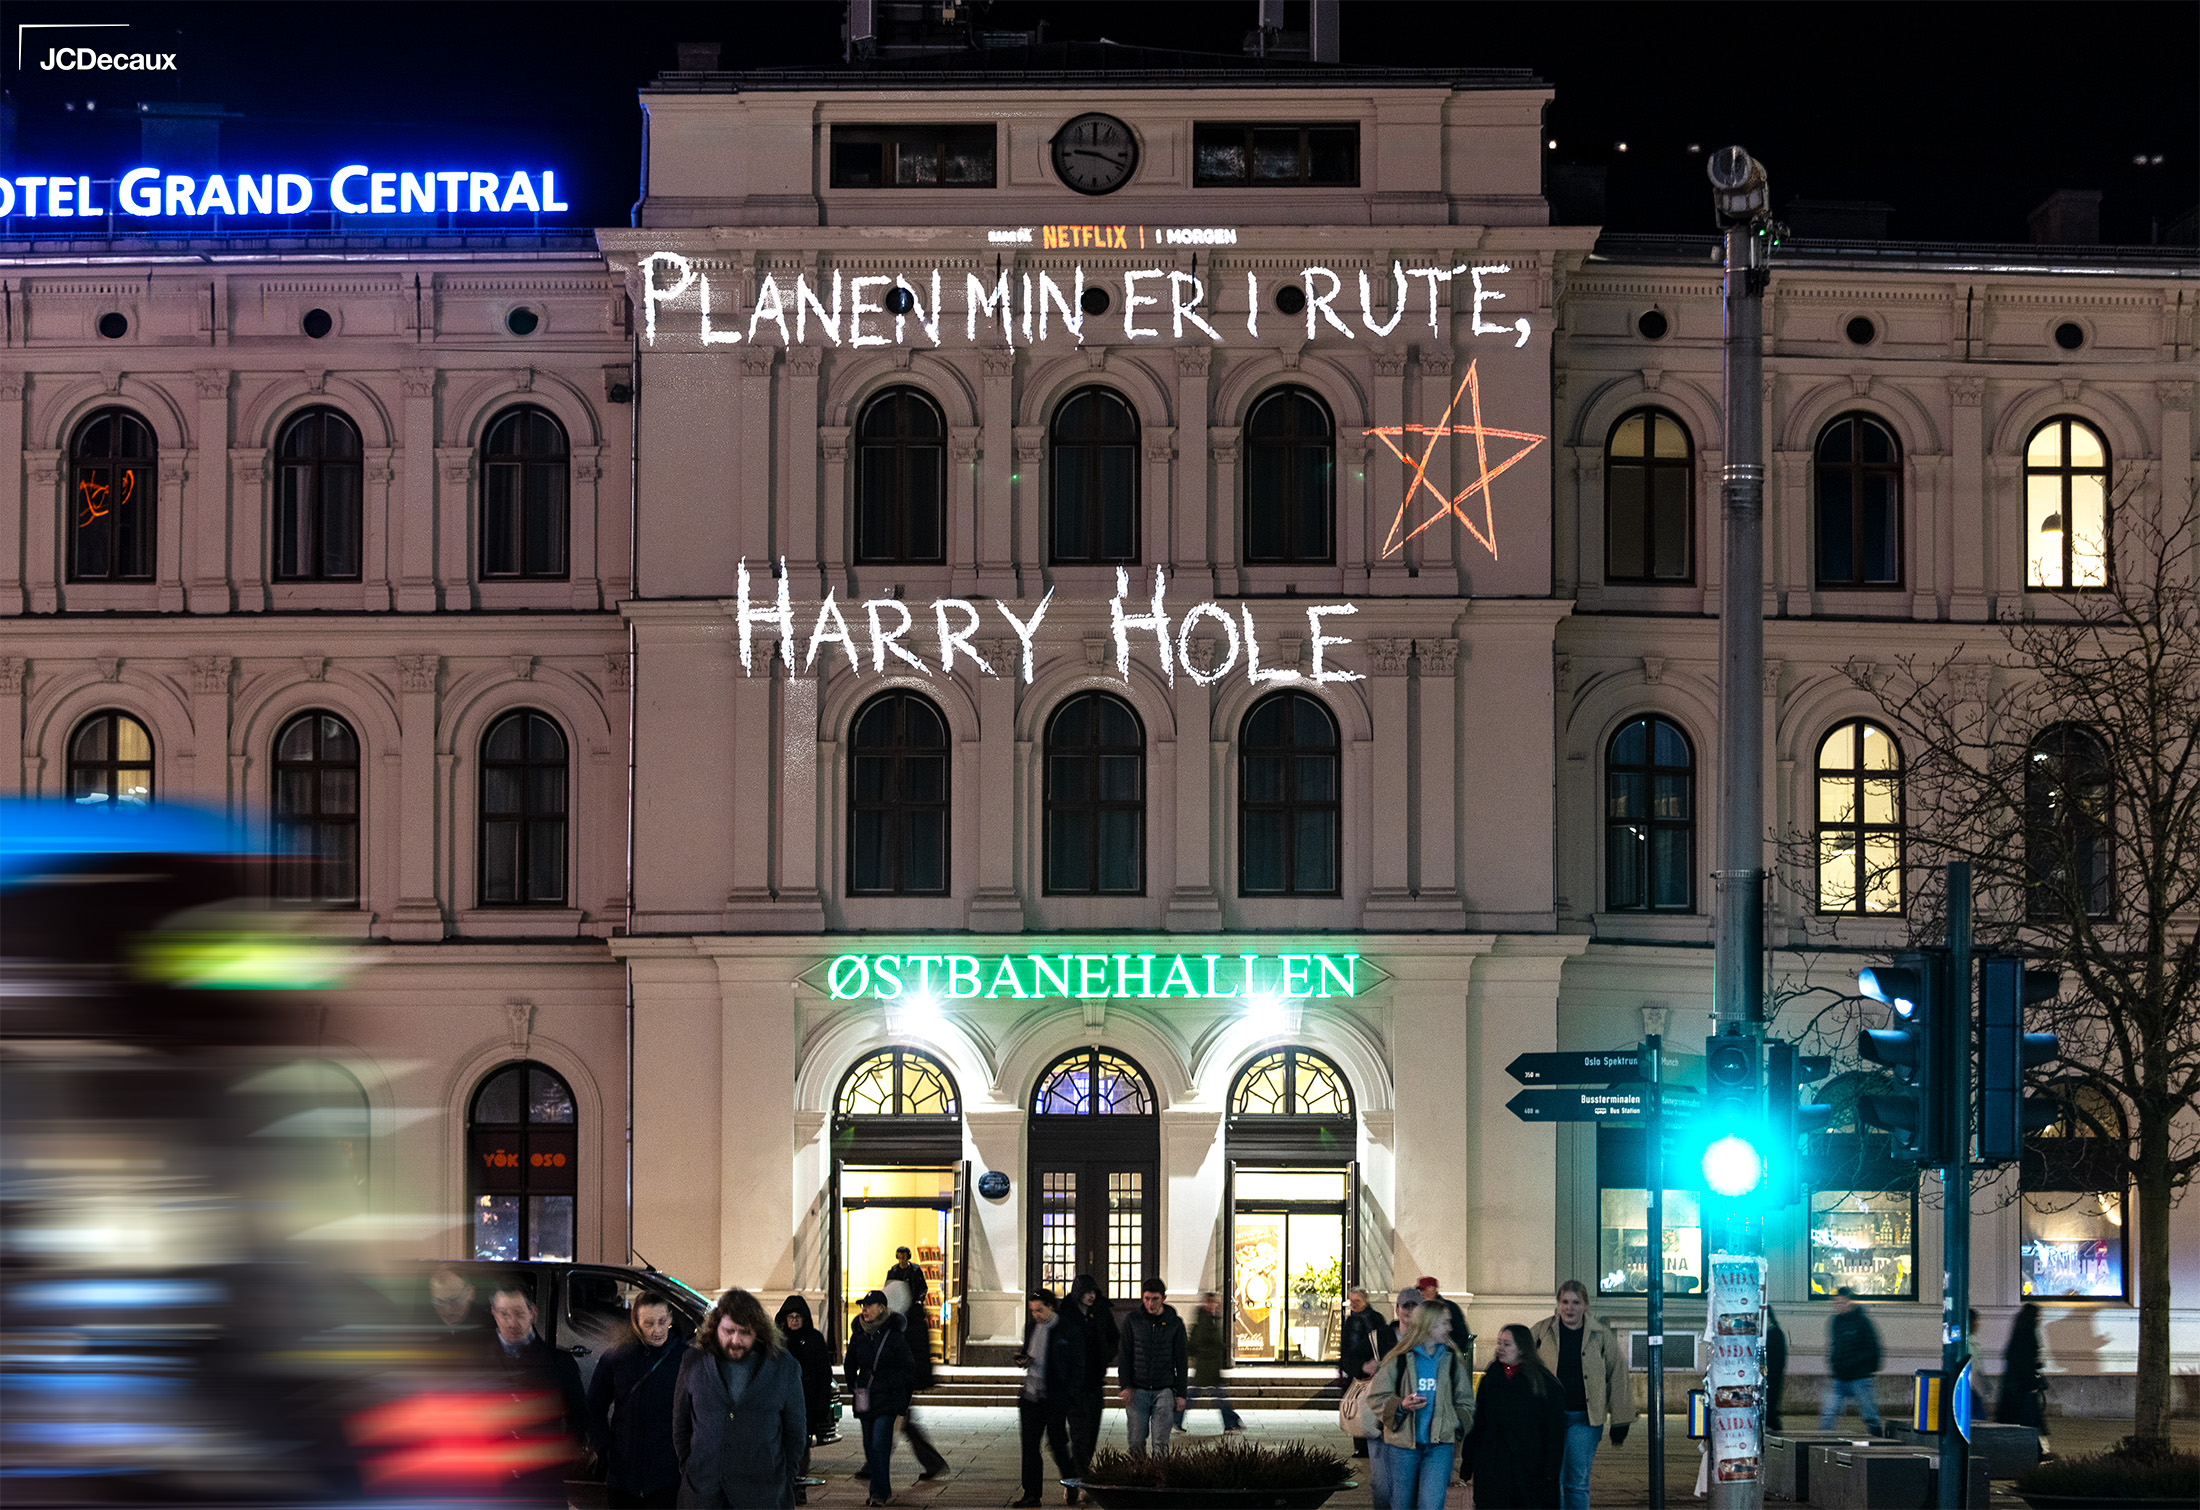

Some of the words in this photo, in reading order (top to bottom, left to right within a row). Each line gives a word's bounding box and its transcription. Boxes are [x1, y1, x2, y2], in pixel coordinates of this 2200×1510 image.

[118, 167, 313, 217] GRAND
[330, 164, 569, 214] CENTRAL
[1042, 224, 1128, 250] NETFLIX
[1166, 228, 1238, 245] MORGEN
[638, 251, 942, 350] PLANEN
[966, 266, 1085, 353] MIN
[1124, 267, 1226, 342] ER
[1247, 271, 1259, 338] I
[1301, 260, 1532, 348] RUTE,
[735, 555, 1056, 685] HARRY
[1109, 563, 1367, 688] HOLE
[827, 954, 1360, 1000] ØSTBANEHALLEN
[1584, 1057, 1601, 1067] Oslo
[1581, 1095, 1640, 1104] Bussterminalen
[1719, 1272, 1757, 1286] AIDA
[1715, 1345, 1754, 1358] AIDA
[1716, 1417, 1753, 1431] AIDA
